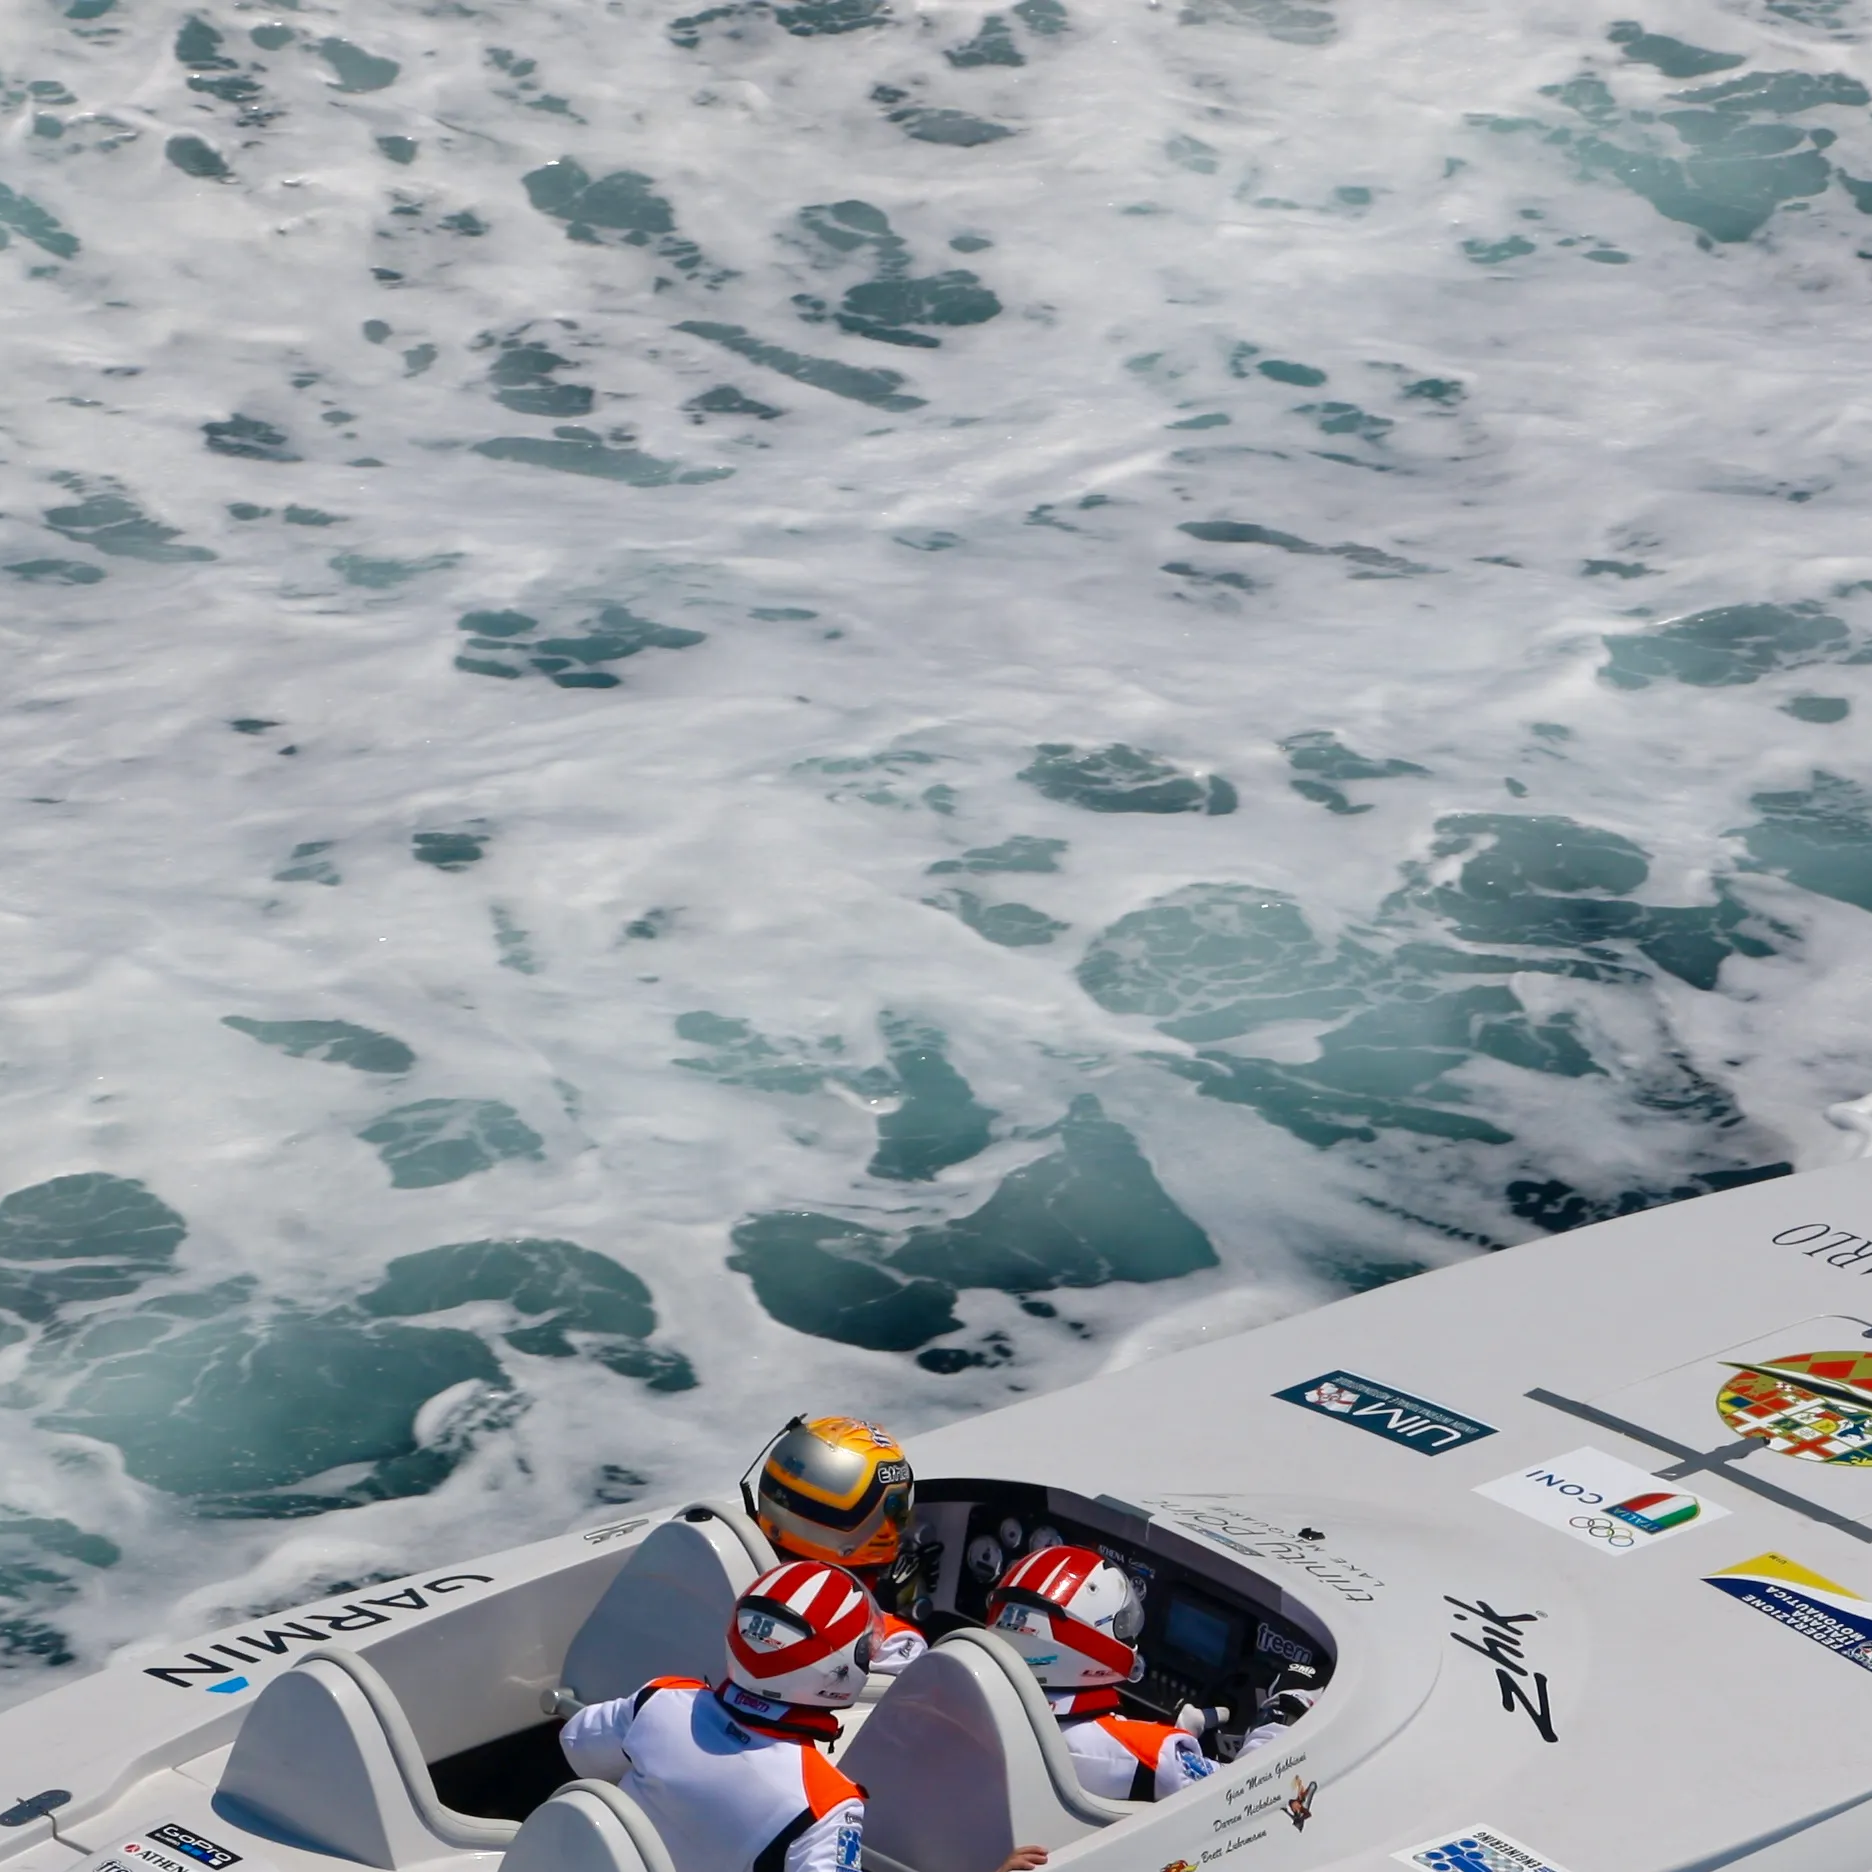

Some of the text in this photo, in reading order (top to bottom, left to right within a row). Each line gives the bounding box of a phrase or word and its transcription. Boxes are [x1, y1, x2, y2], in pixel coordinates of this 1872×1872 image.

[1352, 1401, 1462, 1447] UIM
[1526, 1469, 1603, 1504] CONI
[1612, 1507, 1661, 1532] ITALIA
[1255, 1541, 1375, 1602] trinity
[142, 1574, 495, 1688] GARMIN
[1741, 1594, 1844, 1650] FEDERAZIONE
[1765, 1586, 1866, 1643] MOTONAUTICA
[1791, 1610, 1856, 1646] ITALIANA
[1257, 1623, 1313, 1664] freem
[1213, 1794, 1282, 1832] Darren Nicholson
[1225, 1789, 1245, 1805] Gian
[163, 1826, 232, 1862] GoPro
[1200, 1847, 1223, 1864] Brett
[1472, 1831, 1543, 1869] ENGINEERING
